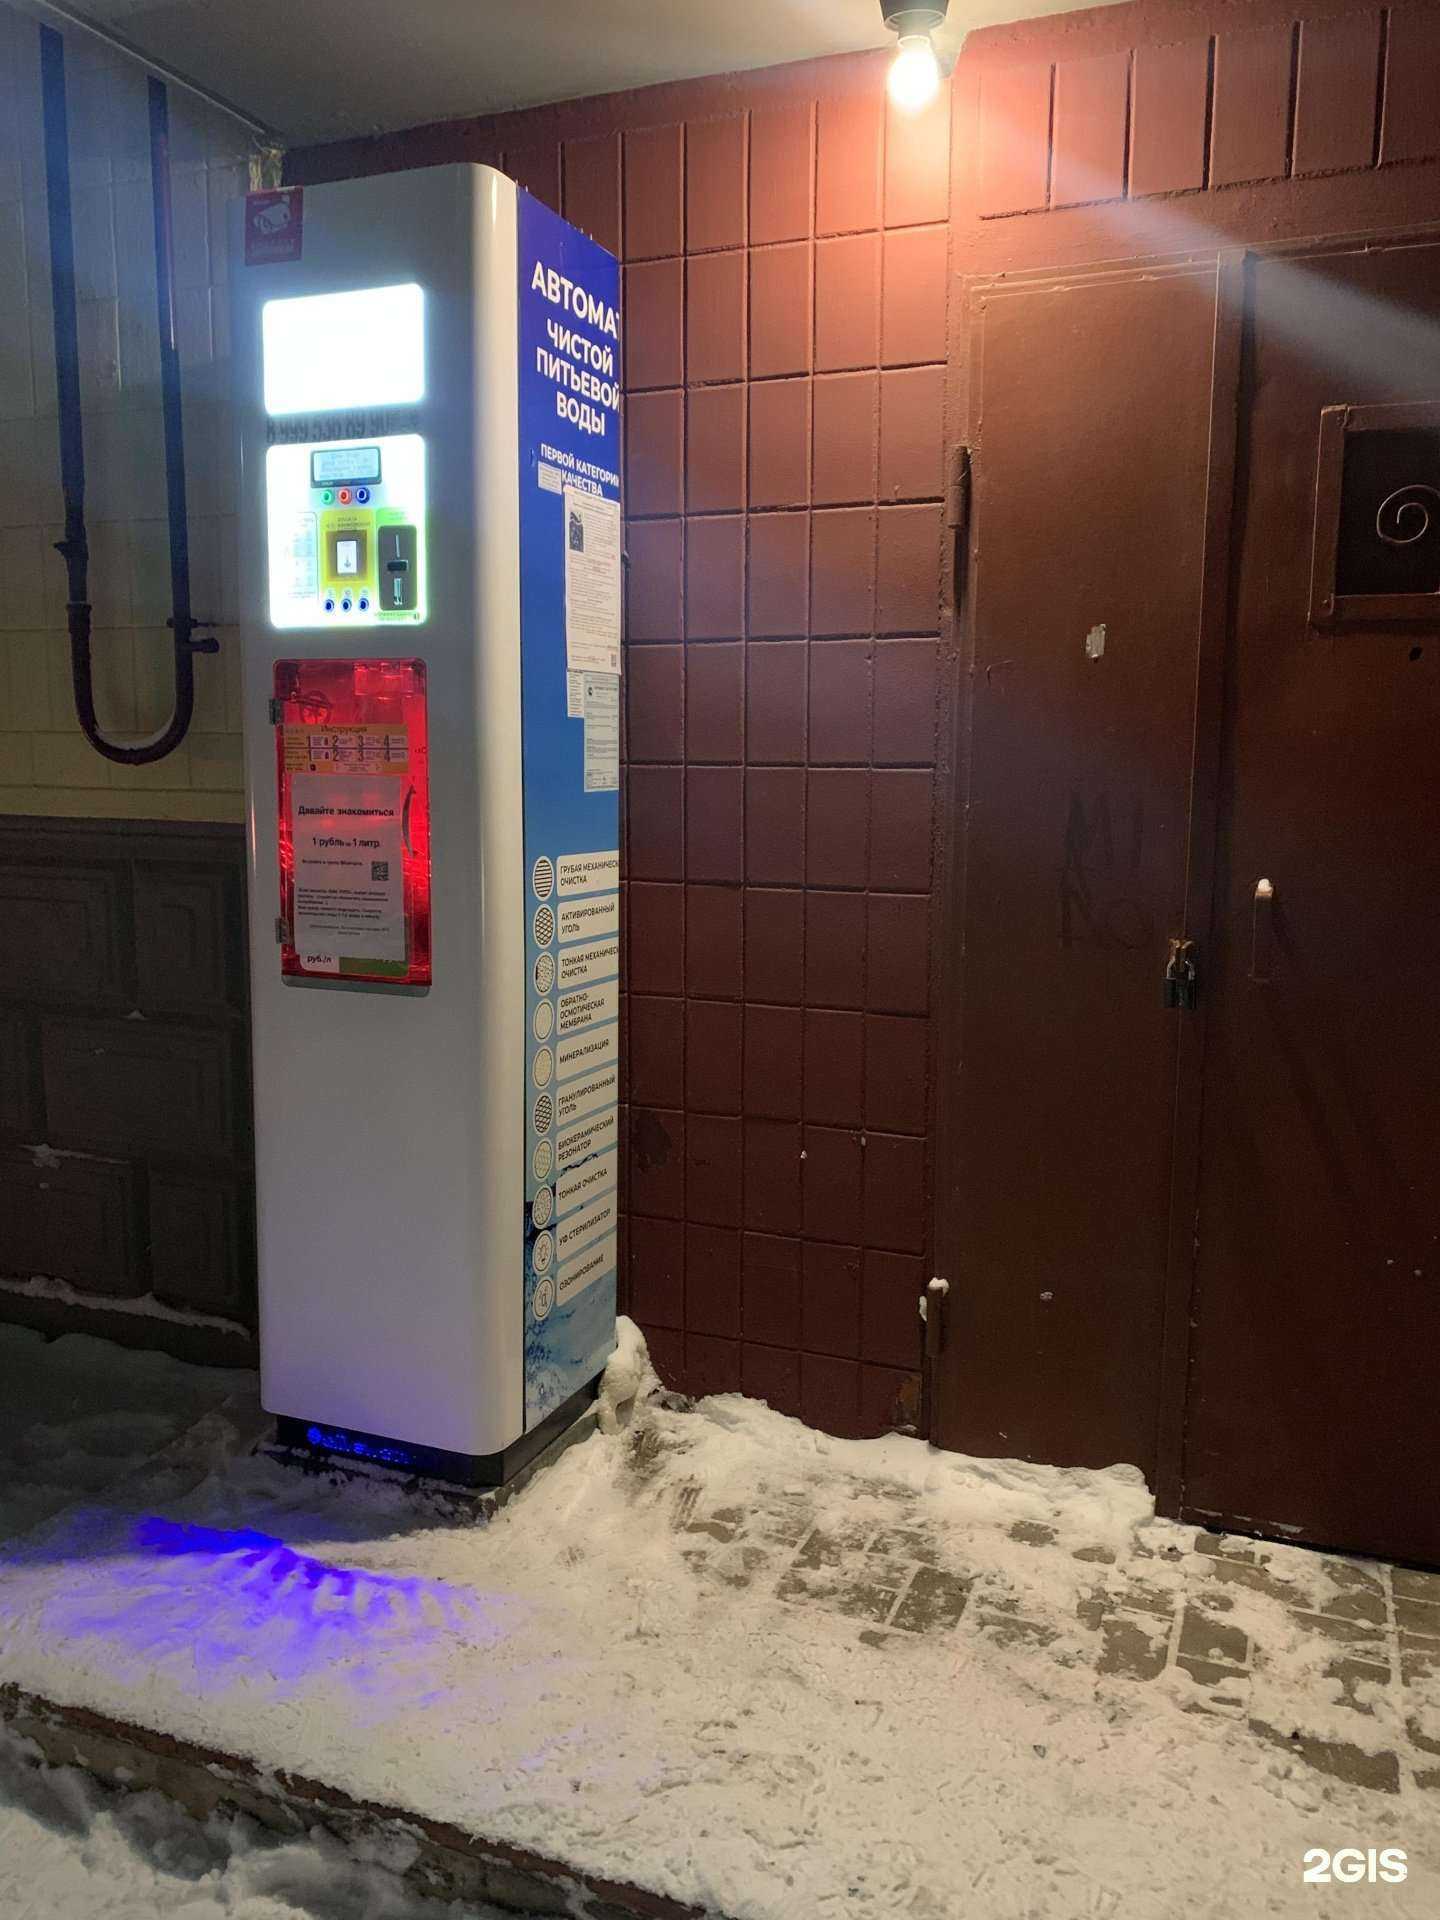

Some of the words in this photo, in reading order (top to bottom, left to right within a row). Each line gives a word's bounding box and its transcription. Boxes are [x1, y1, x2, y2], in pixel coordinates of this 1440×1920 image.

[546, 317, 614, 378] ЧИСТОЙ
[536, 345, 620, 412] ПИТЬЕВОЙ
[556, 390, 606, 437] ВОДЫ
[540, 443, 575, 470] ПЕРВОЙ
[561, 469, 604, 497] КАЧЕСТВА
[298, 805, 335, 816] Давайте
[336, 807, 395, 817] знакомиться
[312, 837, 317, 846] 1
[319, 837, 345, 849] рубль
[352, 838, 358, 847] 1
[358, 839, 381, 849] литр
[560, 863, 582, 874] ГРУБАЯ
[560, 875, 588, 887] ОЧИСТКА
[561, 902, 615, 921] АКТИВИРОВАННЫЙ
[561, 924, 580, 935] УГОЛЬ
[561, 954, 585, 967] ТОНКАЯ
[561, 965, 588, 979] ОЧИСТКА
[560, 998, 605, 1019] ОСМОТИЧЕСКАЯ
[560, 1014, 592, 1030] МЕМБРАНА
[559, 1039, 609, 1064] МИНЕРАЛИЗАЦИЯ
[558, 1073, 616, 1107] ГРАНУЛИРОВАННЫЙ
[559, 1104, 577, 1118] УГОЛЬ
[558, 1115, 614, 1151] БИОКЕРАМИЧЕСКИЙ
[558, 1139, 592, 1162] РЕЗОНАТОР
[558, 1182, 581, 1200] ТОНКАЯ
[582, 1168, 608, 1187] ОЧИСТКА
[568, 1207, 611, 1240] СТЕРИЛИЗАТОР
[559, 1253, 604, 1291] ОЗОНИРОВАНИЕ
